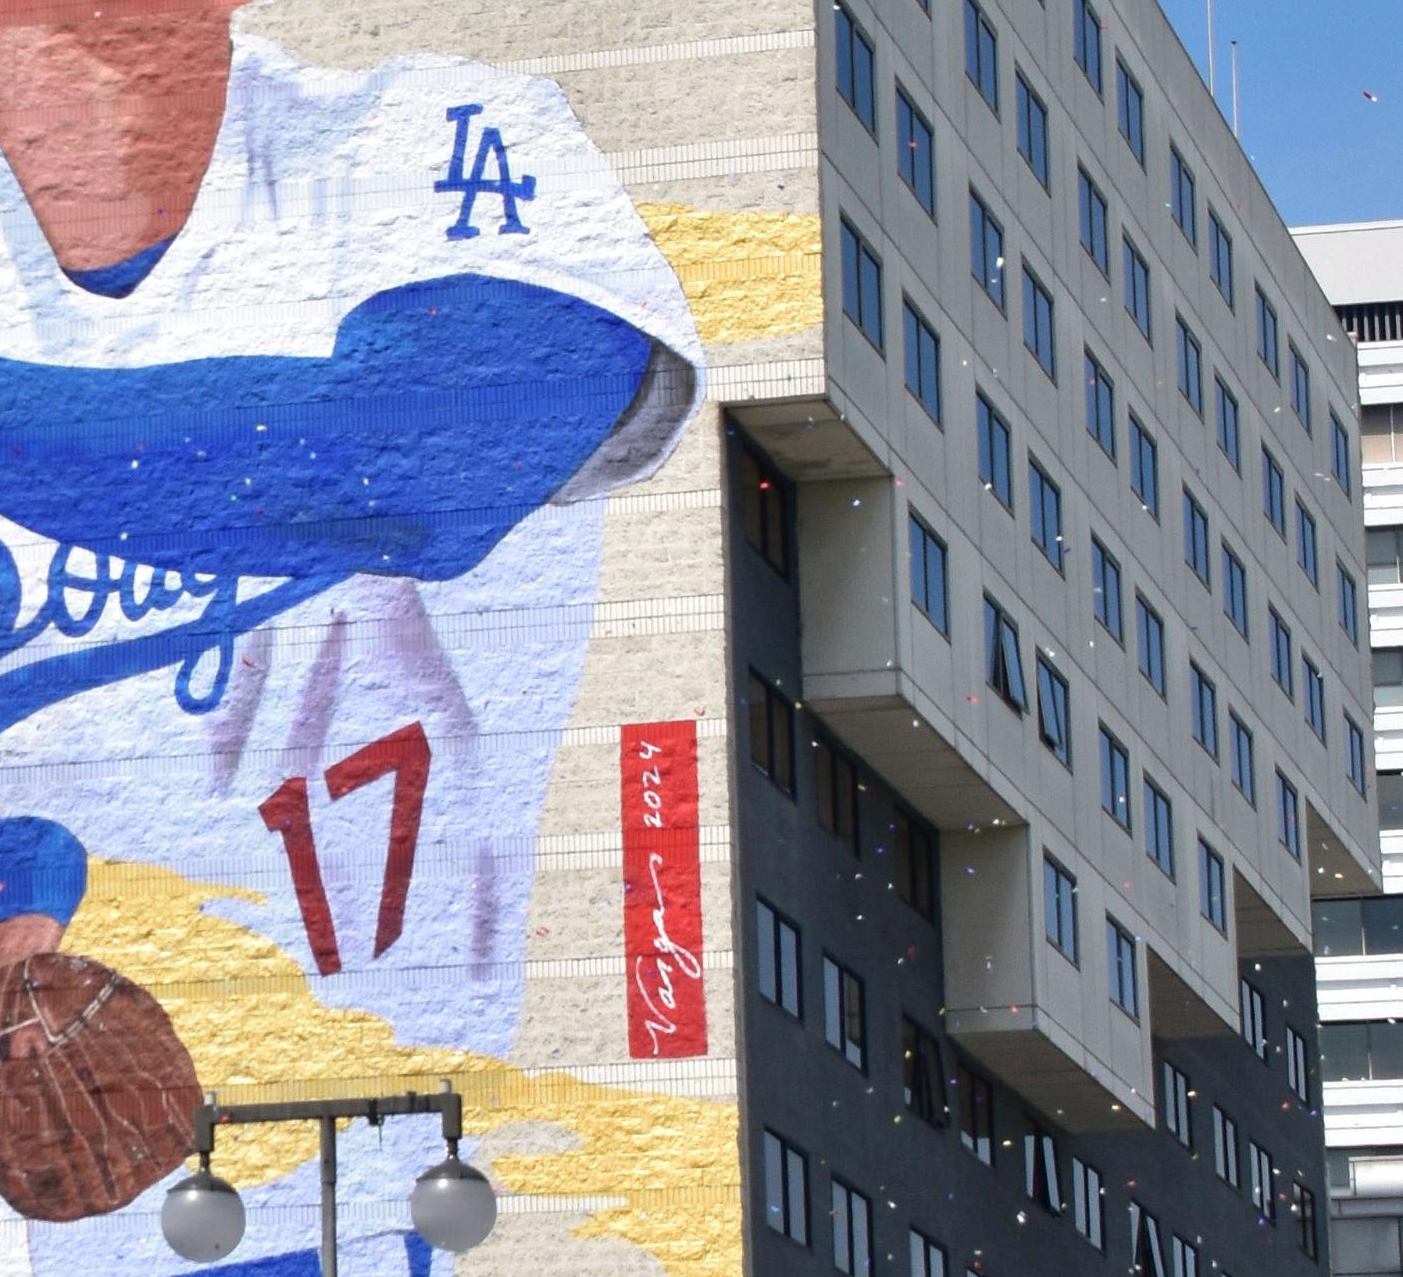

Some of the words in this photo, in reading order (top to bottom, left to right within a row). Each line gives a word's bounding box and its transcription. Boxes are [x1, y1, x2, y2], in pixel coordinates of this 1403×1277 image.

[434, 103, 536, 241] LA
[258, 720, 431, 978] 17
[639, 740, 662, 829] 2024
[634, 853, 701, 1056] Vargas
